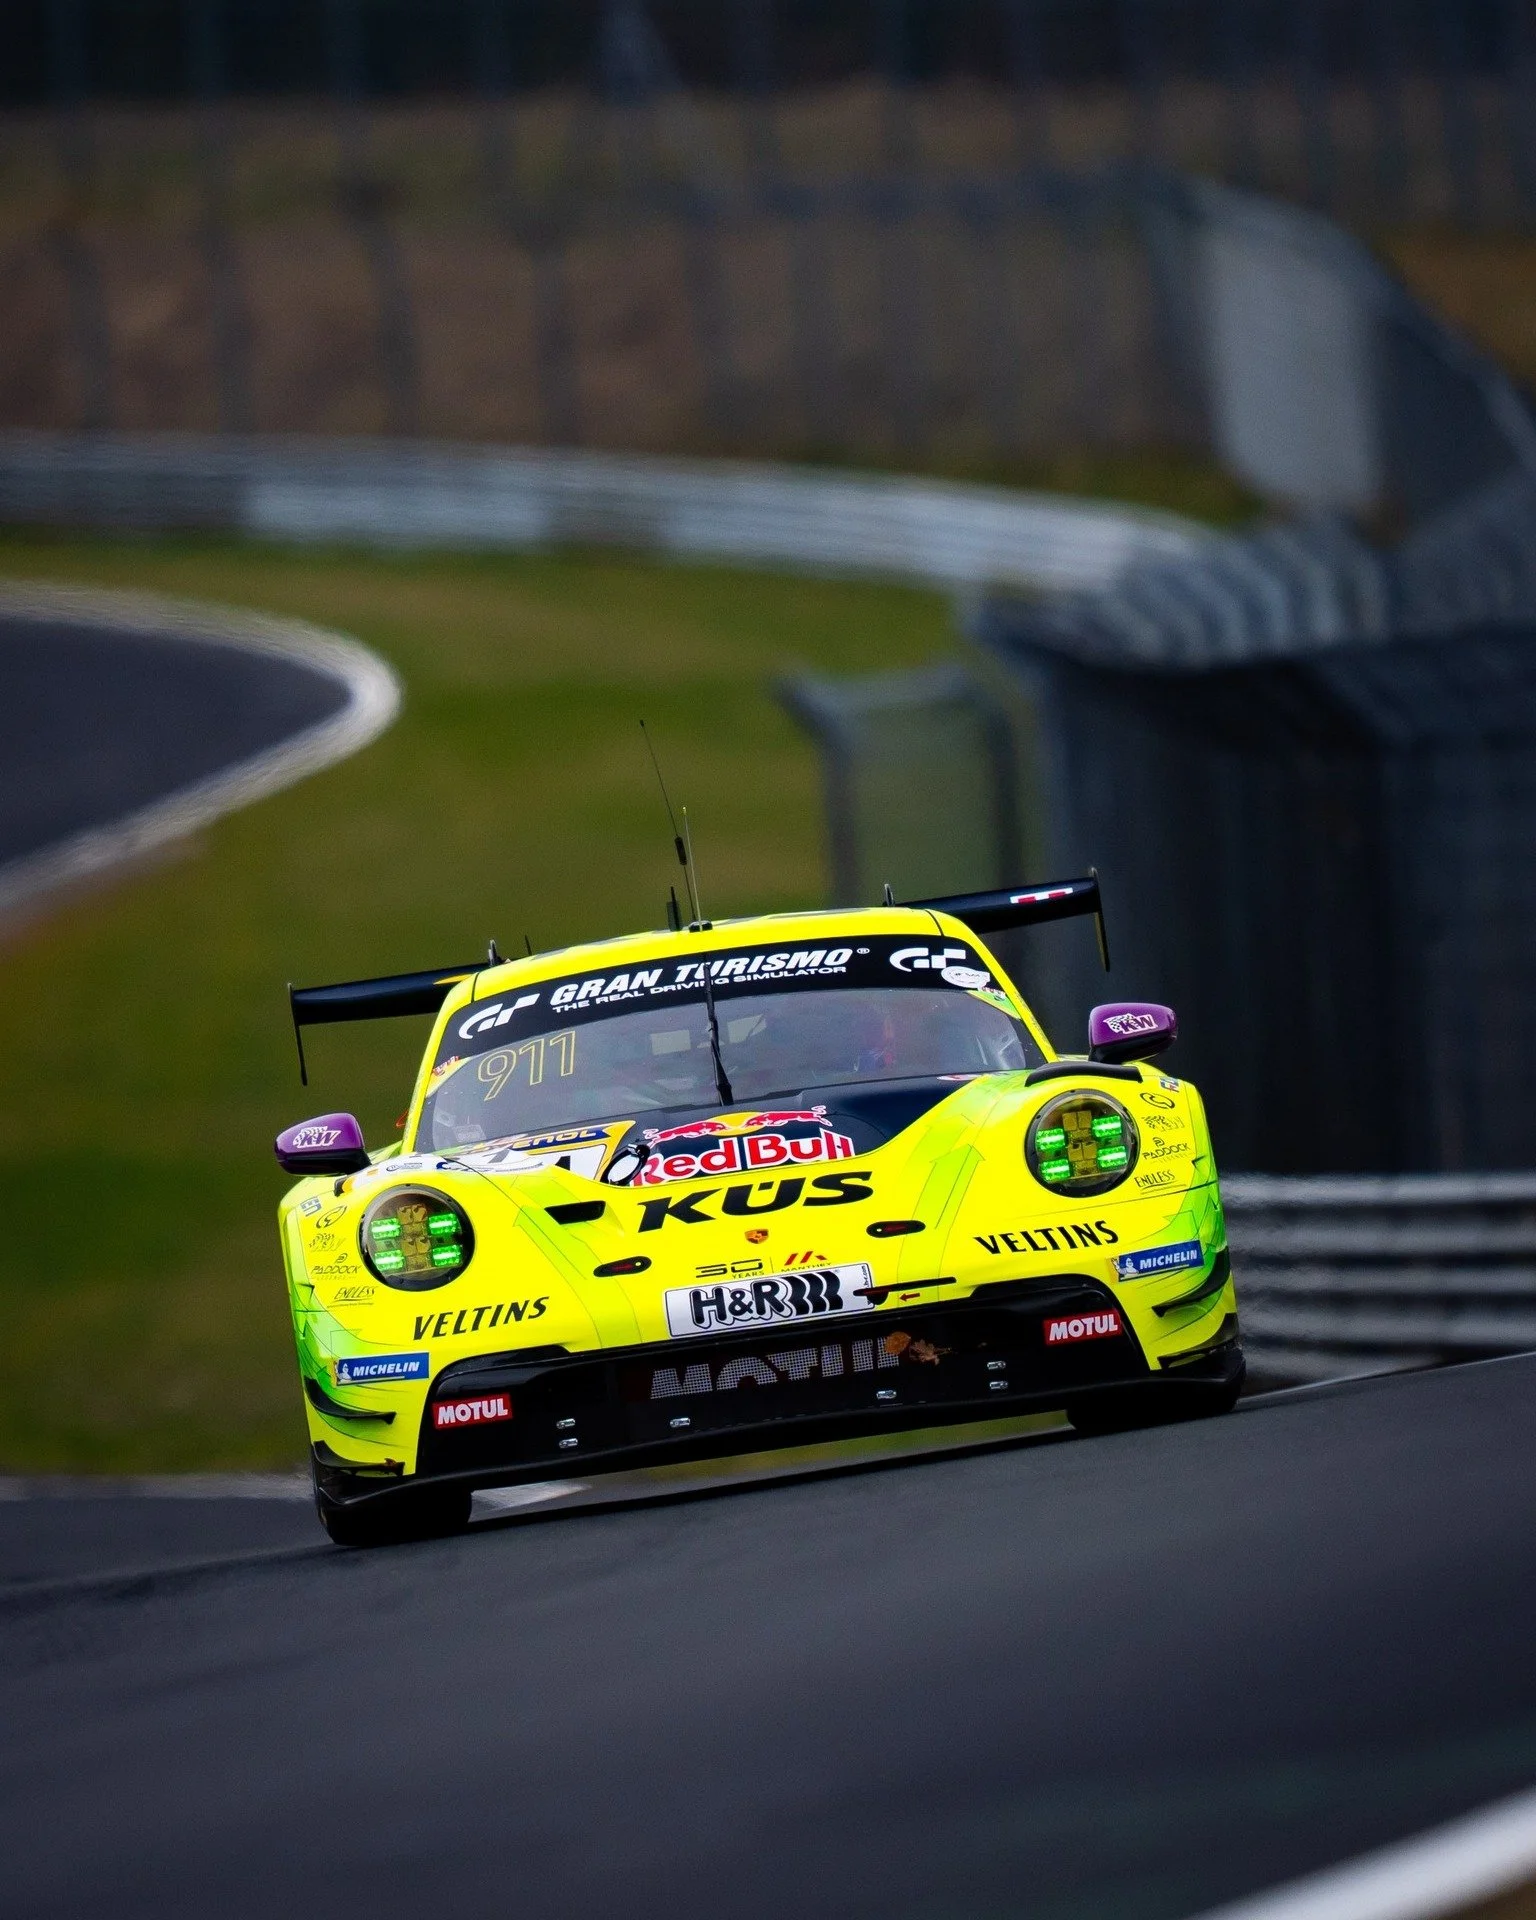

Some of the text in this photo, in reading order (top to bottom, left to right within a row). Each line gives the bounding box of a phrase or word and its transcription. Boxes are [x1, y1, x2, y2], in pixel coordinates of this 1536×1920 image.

[550, 949, 853, 1006] GRAN TURISMO
[552, 1000, 590, 1013] THE
[596, 990, 644, 1004] REAL
[733, 966, 847, 983] SIMULATOR
[1119, 1014, 1158, 1034] KW
[477, 1030, 575, 1101] 911
[299, 1130, 341, 1148] KW
[631, 1127, 854, 1187] Red Bull
[1142, 1143, 1191, 1160] PADDOCK
[1134, 1170, 1176, 1187] ENDLESS
[637, 1171, 873, 1233] KÜS
[973, 1220, 1118, 1255] VELTINS
[311, 1265, 362, 1275] PADDOCK
[780, 1262, 832, 1272] MANTHEY
[1139, 1249, 1198, 1270] MICHELIN
[731, 1271, 765, 1279] YEARS
[334, 1286, 378, 1299] ENDLESS
[689, 1278, 793, 1329] H&R
[413, 1297, 550, 1341] VELTINS
[1049, 1313, 1118, 1341] MOTUL
[352, 1361, 420, 1377] MICHELIN
[437, 1398, 508, 1425] MOTUL
